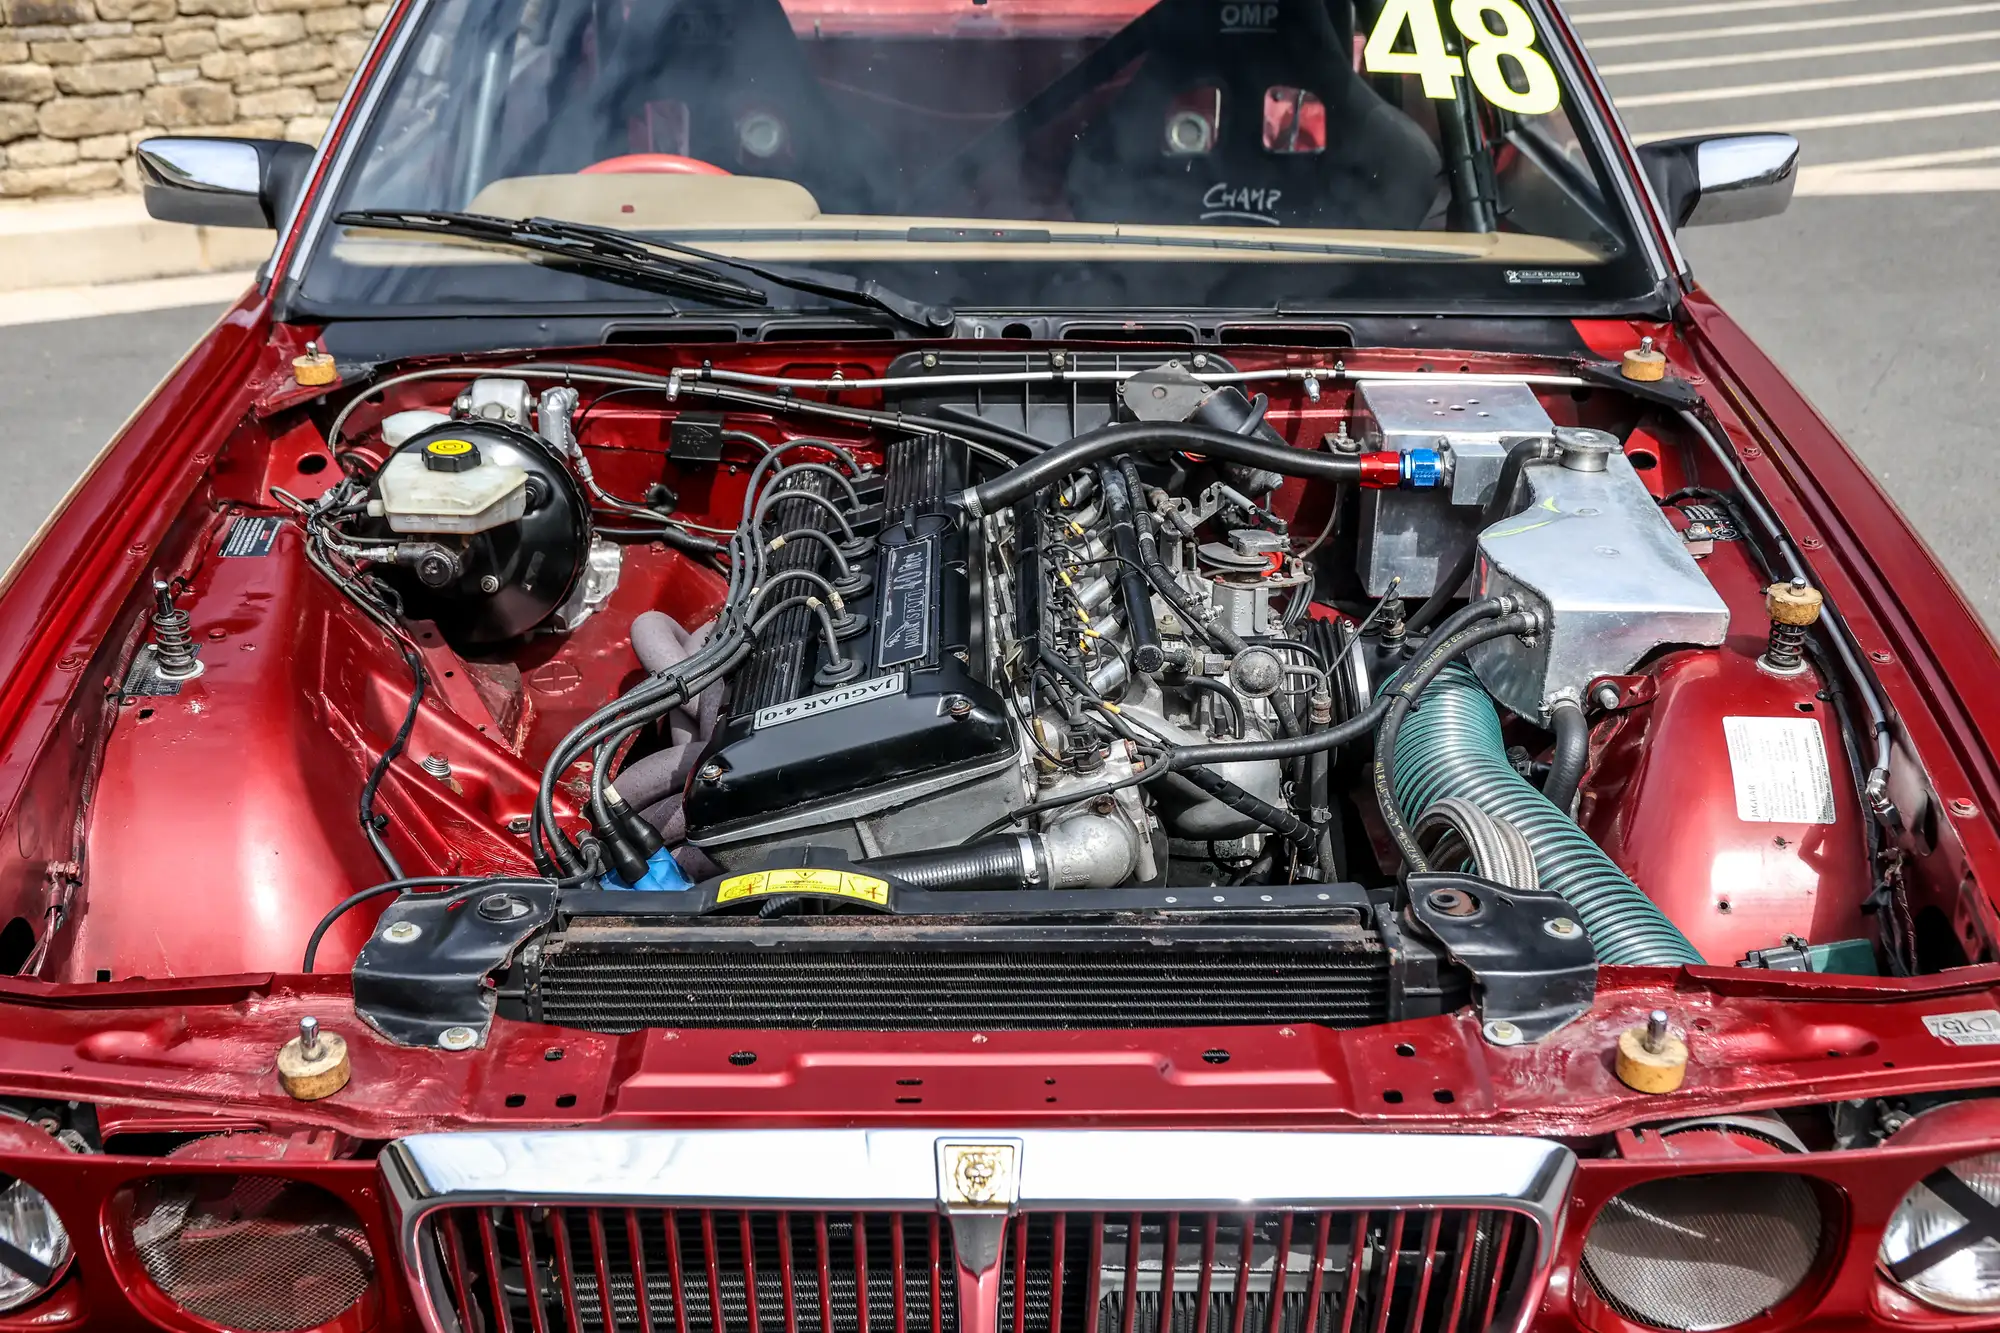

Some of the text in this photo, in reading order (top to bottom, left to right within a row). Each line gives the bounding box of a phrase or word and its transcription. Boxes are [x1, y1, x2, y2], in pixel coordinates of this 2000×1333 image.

[1221, 4, 1279, 26] OMP
[1364, 0, 1560, 114] 48
[1203, 182, 1282, 211] CHAMP
[804, 678, 893, 710] JAGUAR
[1748, 784, 1760, 818] JAGUAR
